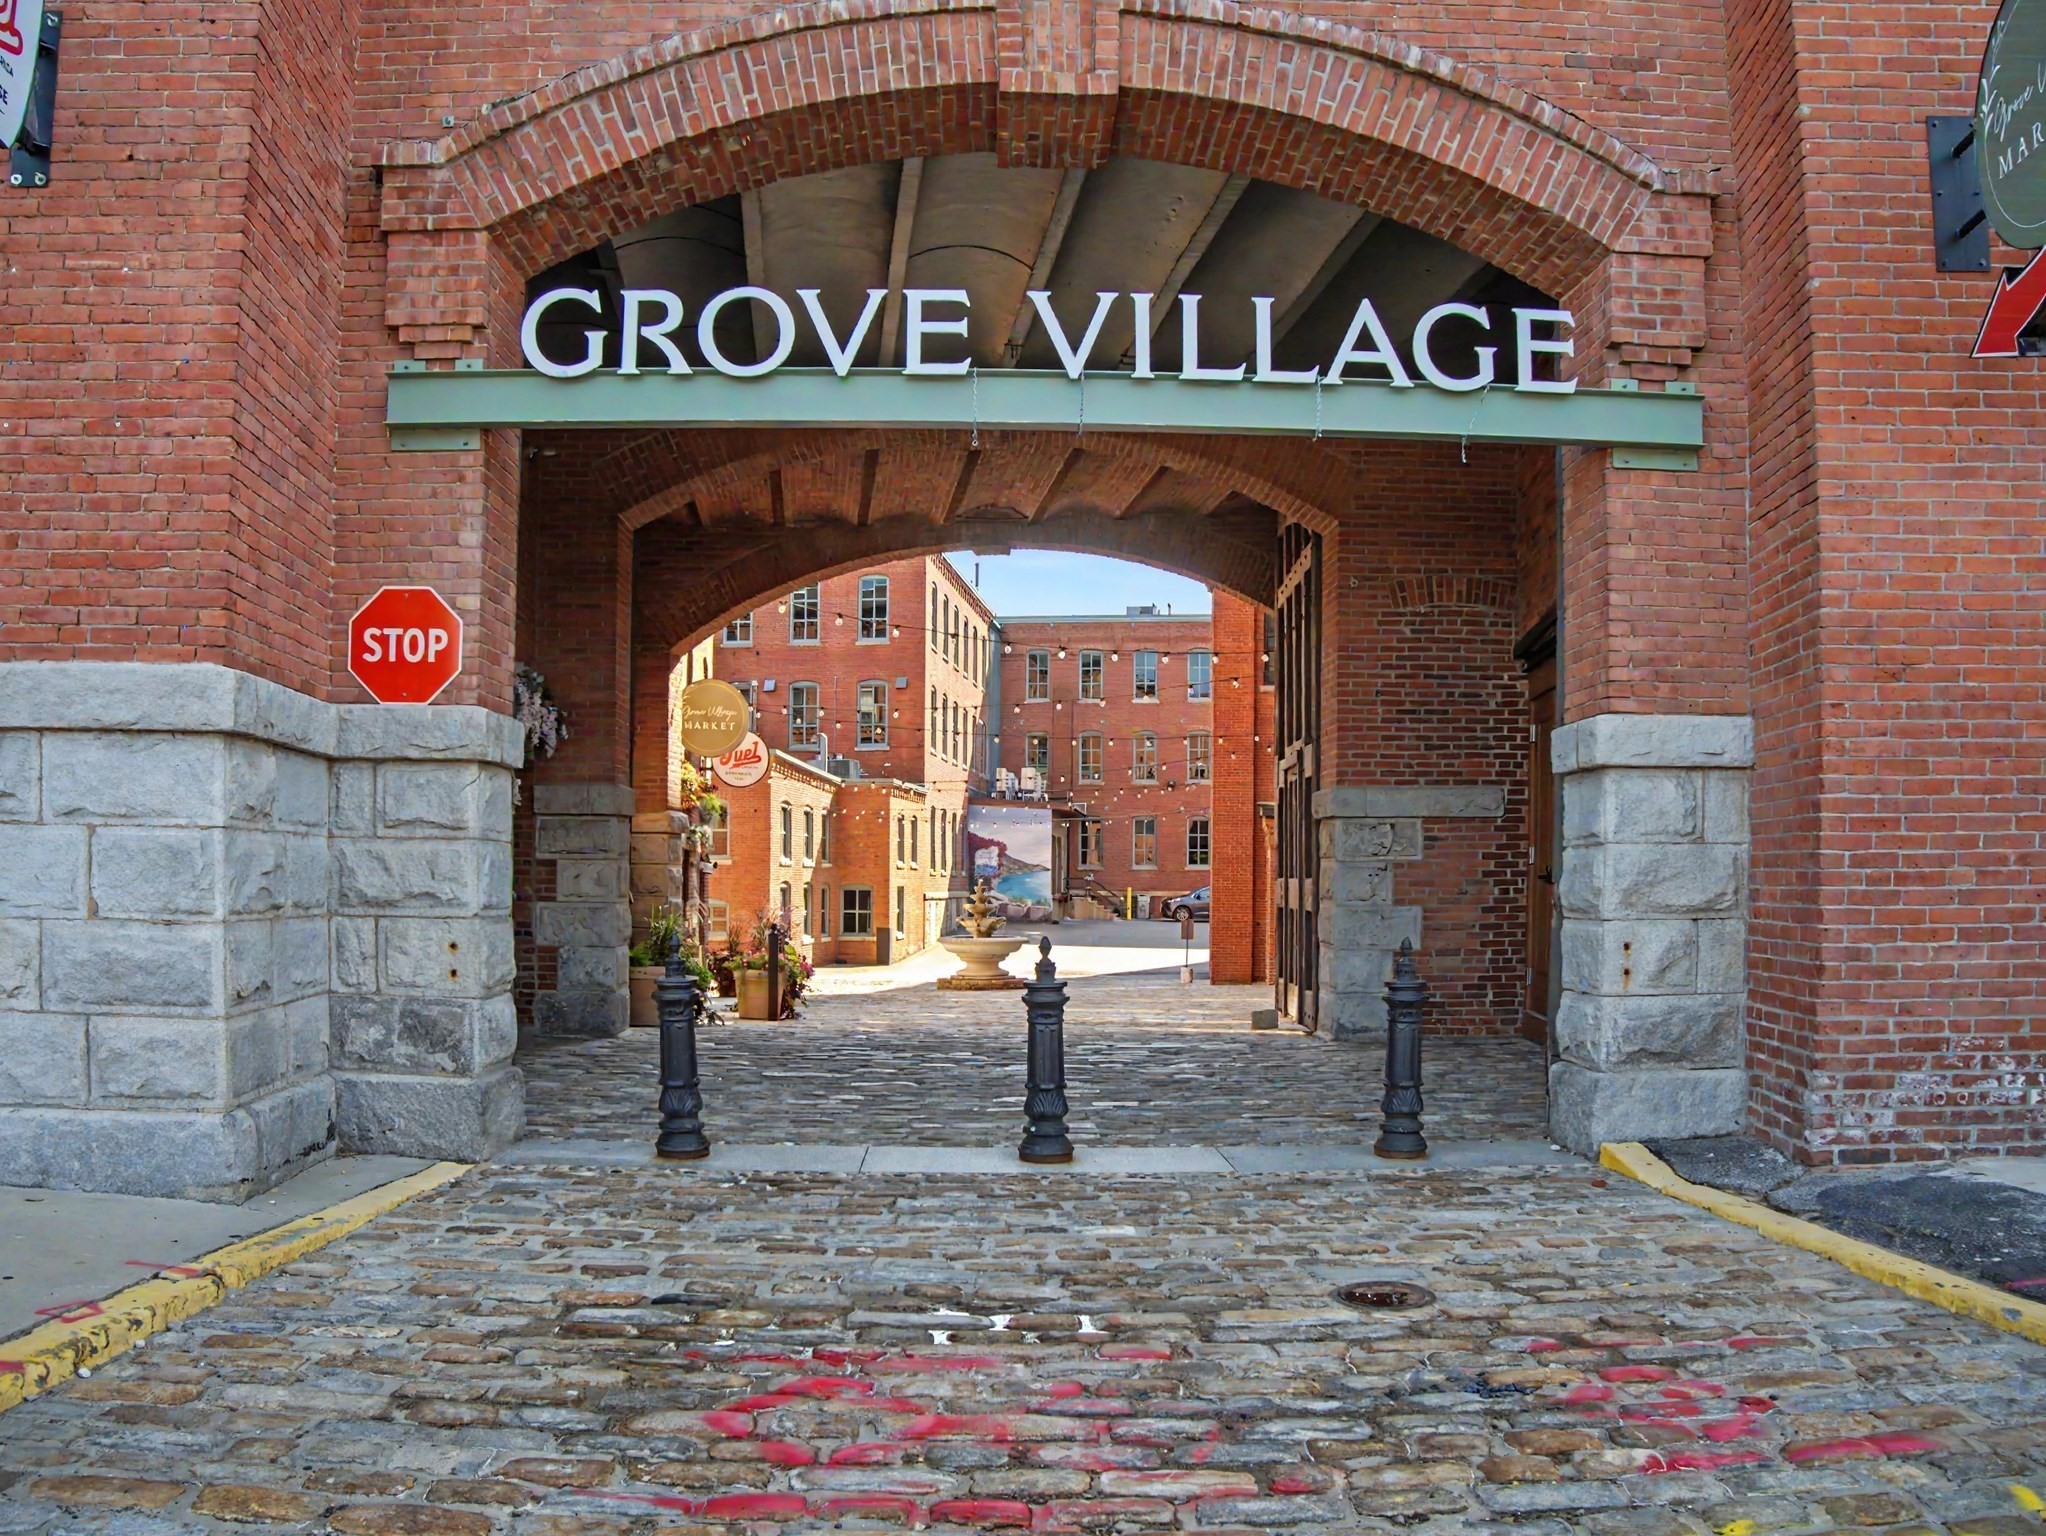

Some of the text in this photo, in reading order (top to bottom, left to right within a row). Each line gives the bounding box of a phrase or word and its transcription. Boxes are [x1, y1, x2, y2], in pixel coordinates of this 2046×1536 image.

[1998, 121, 2046, 180] MAR
[520, 285, 1578, 394] GROVE VILLAGE
[362, 627, 449, 663] STOP
[684, 721, 736, 731] MARKET
